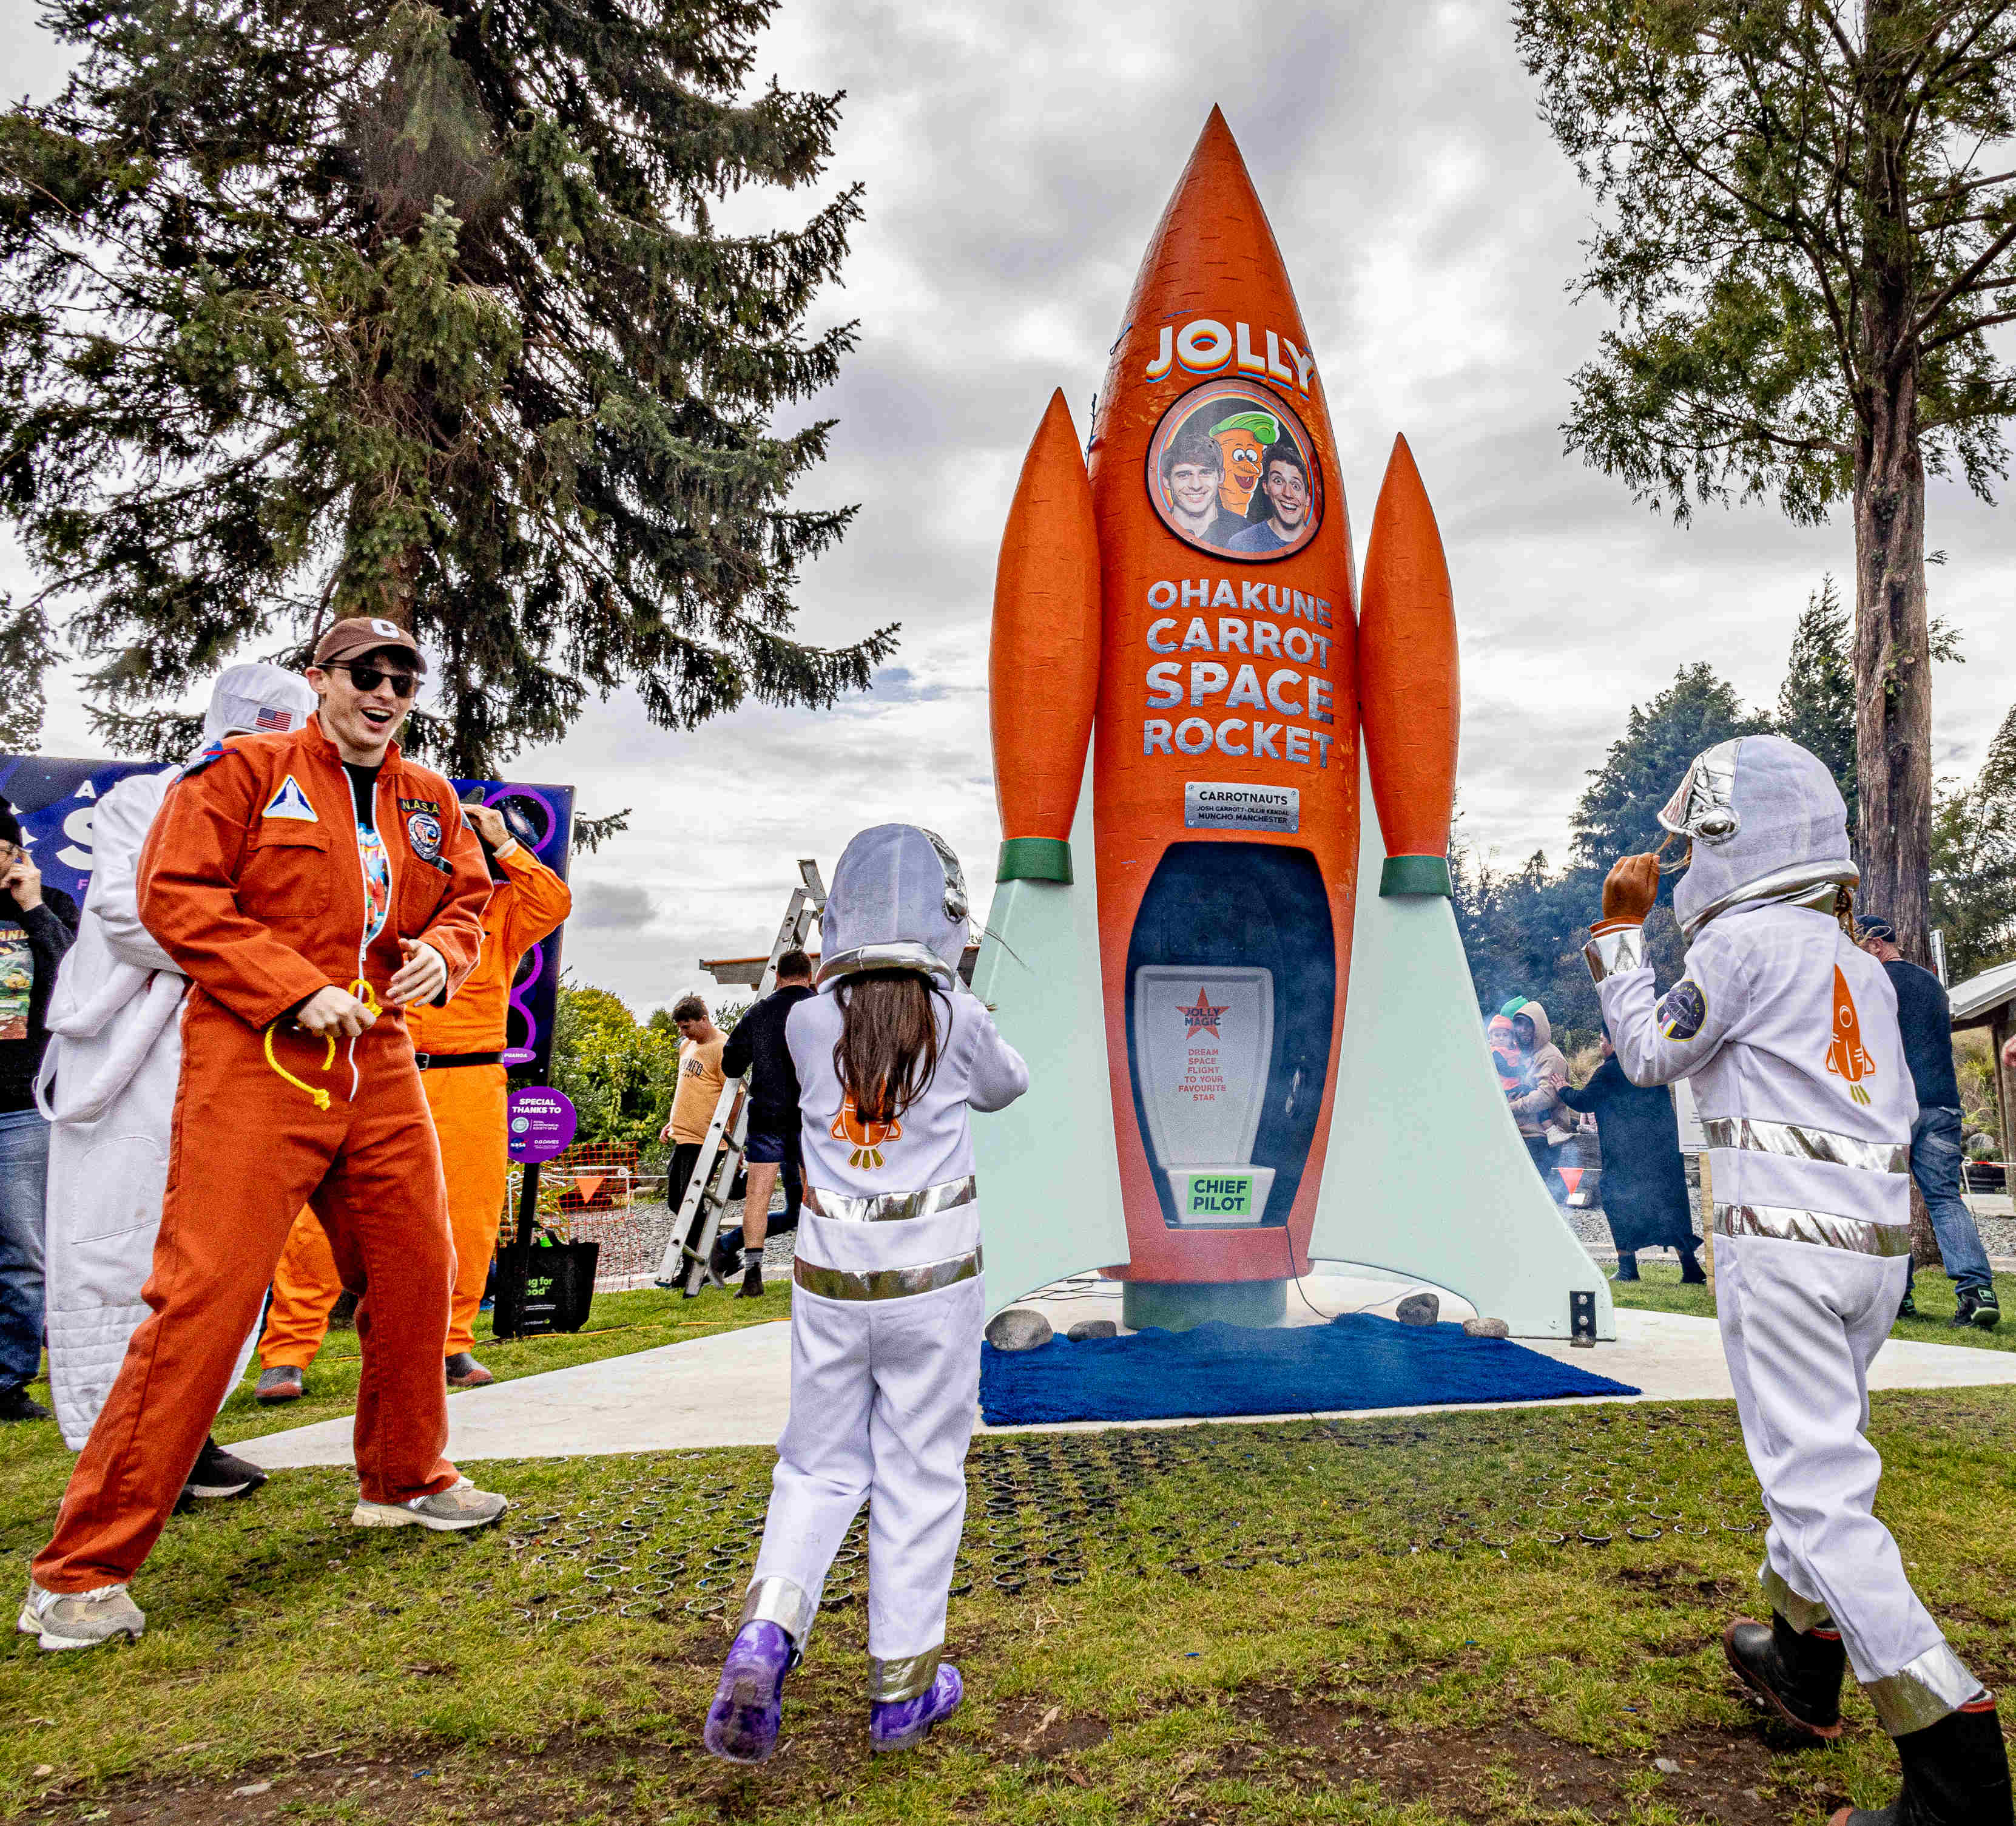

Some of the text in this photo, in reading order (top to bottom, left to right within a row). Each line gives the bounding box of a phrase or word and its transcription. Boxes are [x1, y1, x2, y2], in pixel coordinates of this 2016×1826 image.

[1145, 319, 1314, 397] JOLLY
[1147, 578, 1333, 629] OHAKUNE
[370, 620, 399, 638] C
[1147, 617, 1333, 669] CARROT
[1145, 661, 1334, 725] SPACE
[1144, 717, 1334, 768] ROCKET
[1199, 791, 1287, 805] CARROTNAUTS
[1236, 814, 1287, 823] MANCHESTER
[1186, 1008, 1220, 1016] JOLLY
[1194, 1179, 1248, 1194] CHIEF
[1193, 1197, 1245, 1211] PILOT
[539, 1276, 553, 1285] for
